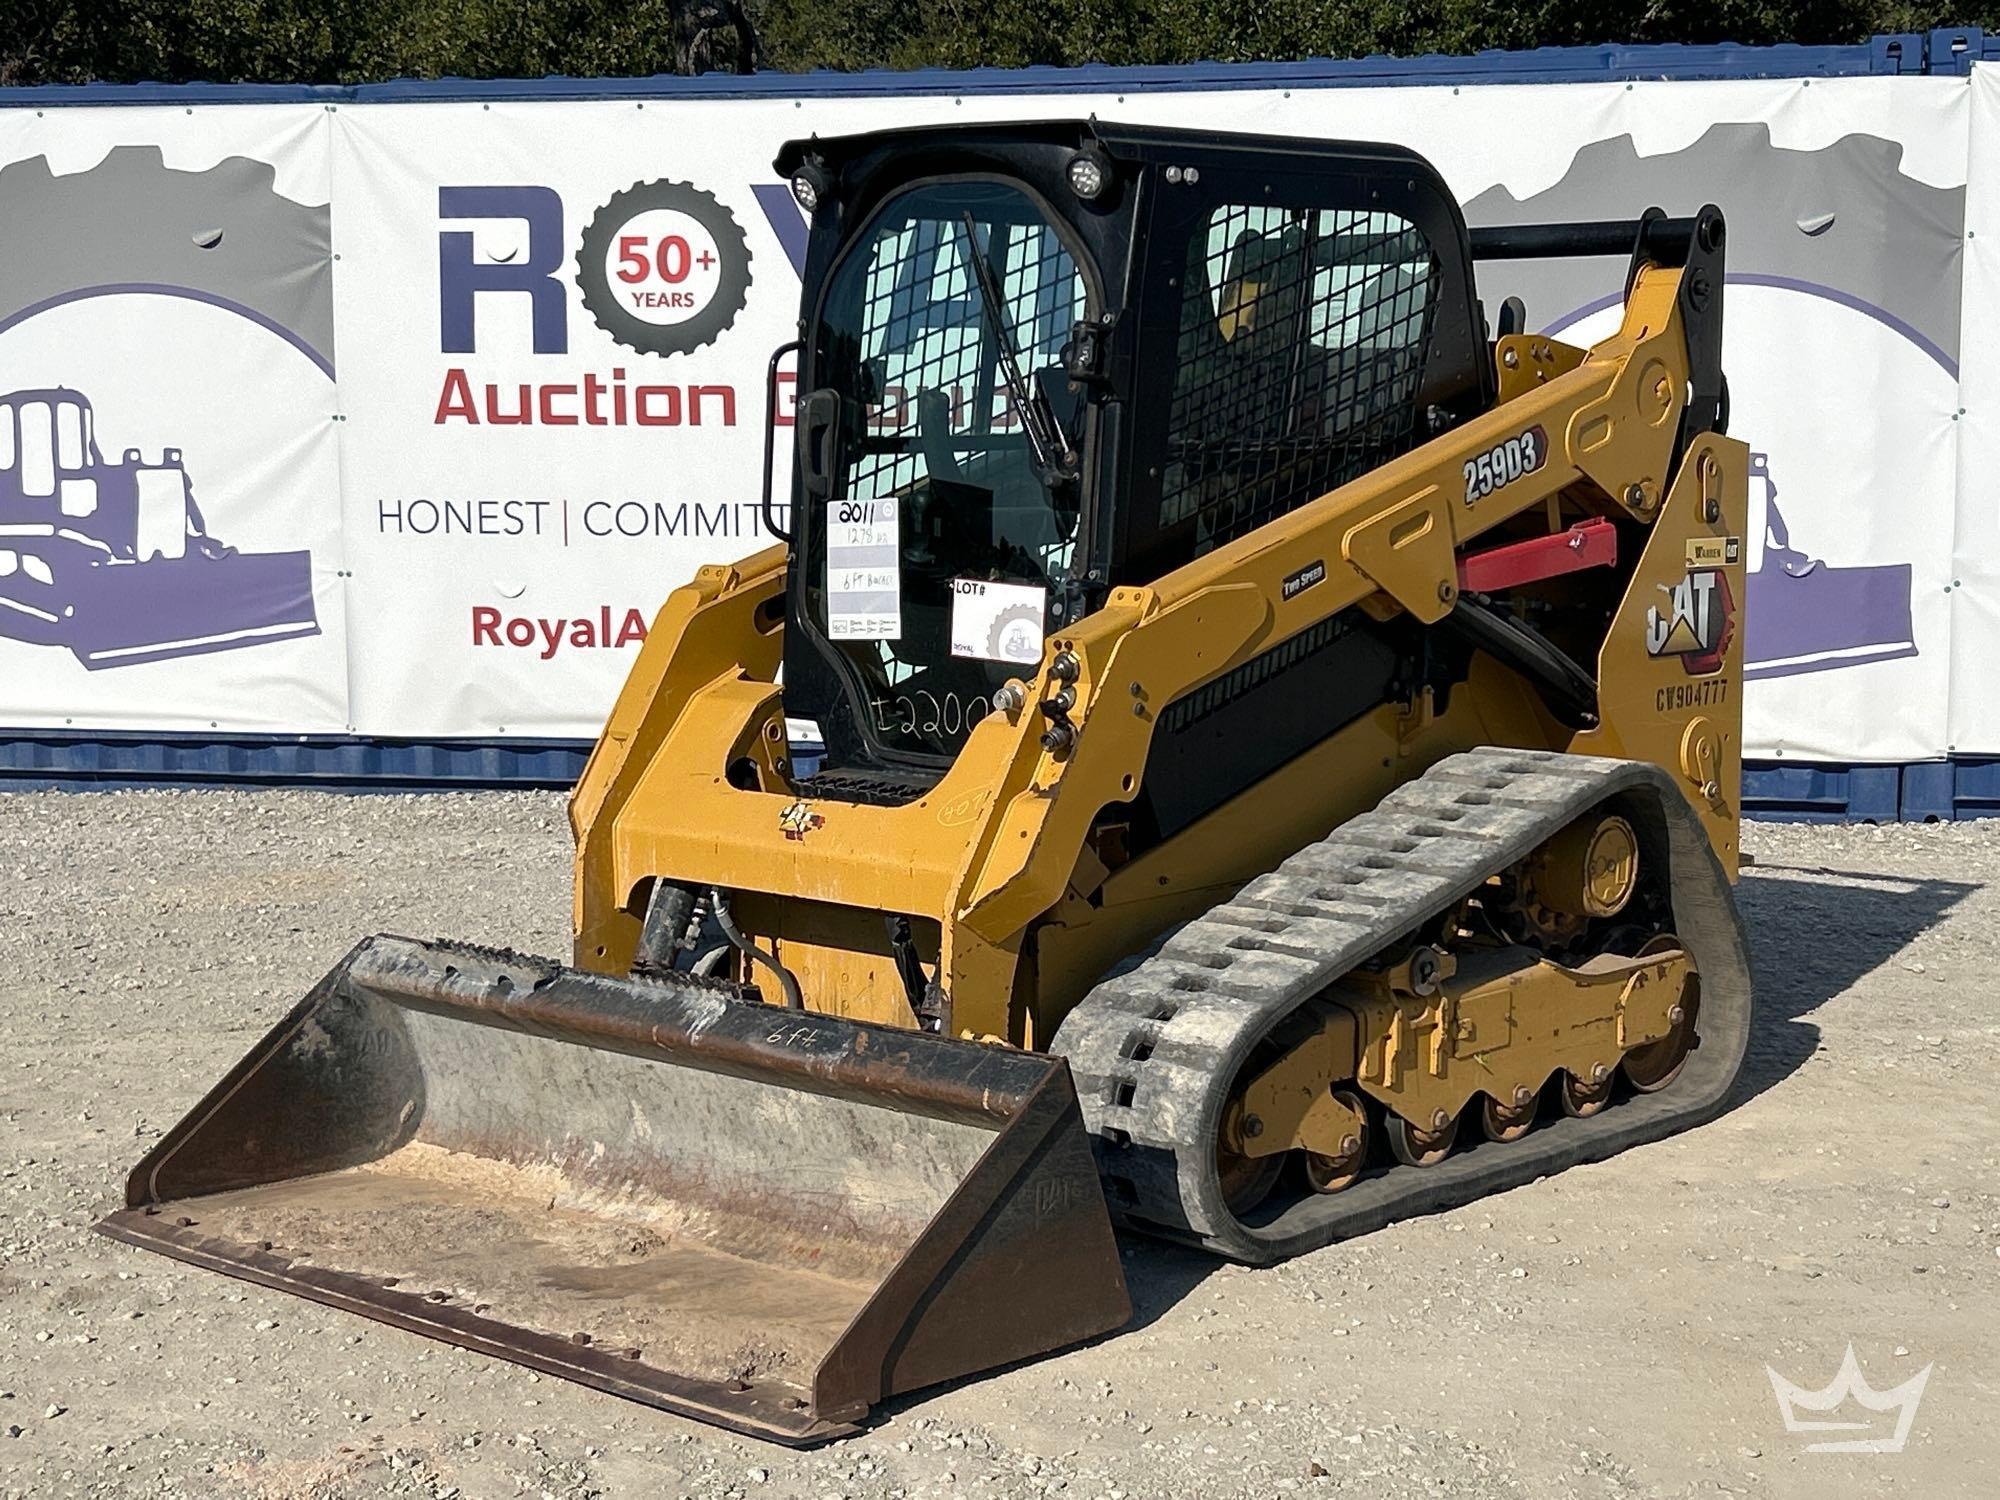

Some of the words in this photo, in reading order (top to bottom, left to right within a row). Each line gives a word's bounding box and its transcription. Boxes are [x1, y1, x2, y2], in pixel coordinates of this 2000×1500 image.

[616, 235, 717, 285] 50+
[631, 292, 695, 308] YEARS
[434, 368, 737, 427] Auction
[1463, 432, 1537, 503] 259D3
[378, 500, 550, 535] HONEST
[839, 502, 875, 526] 2011
[472, 605, 649, 660] RoyalA
